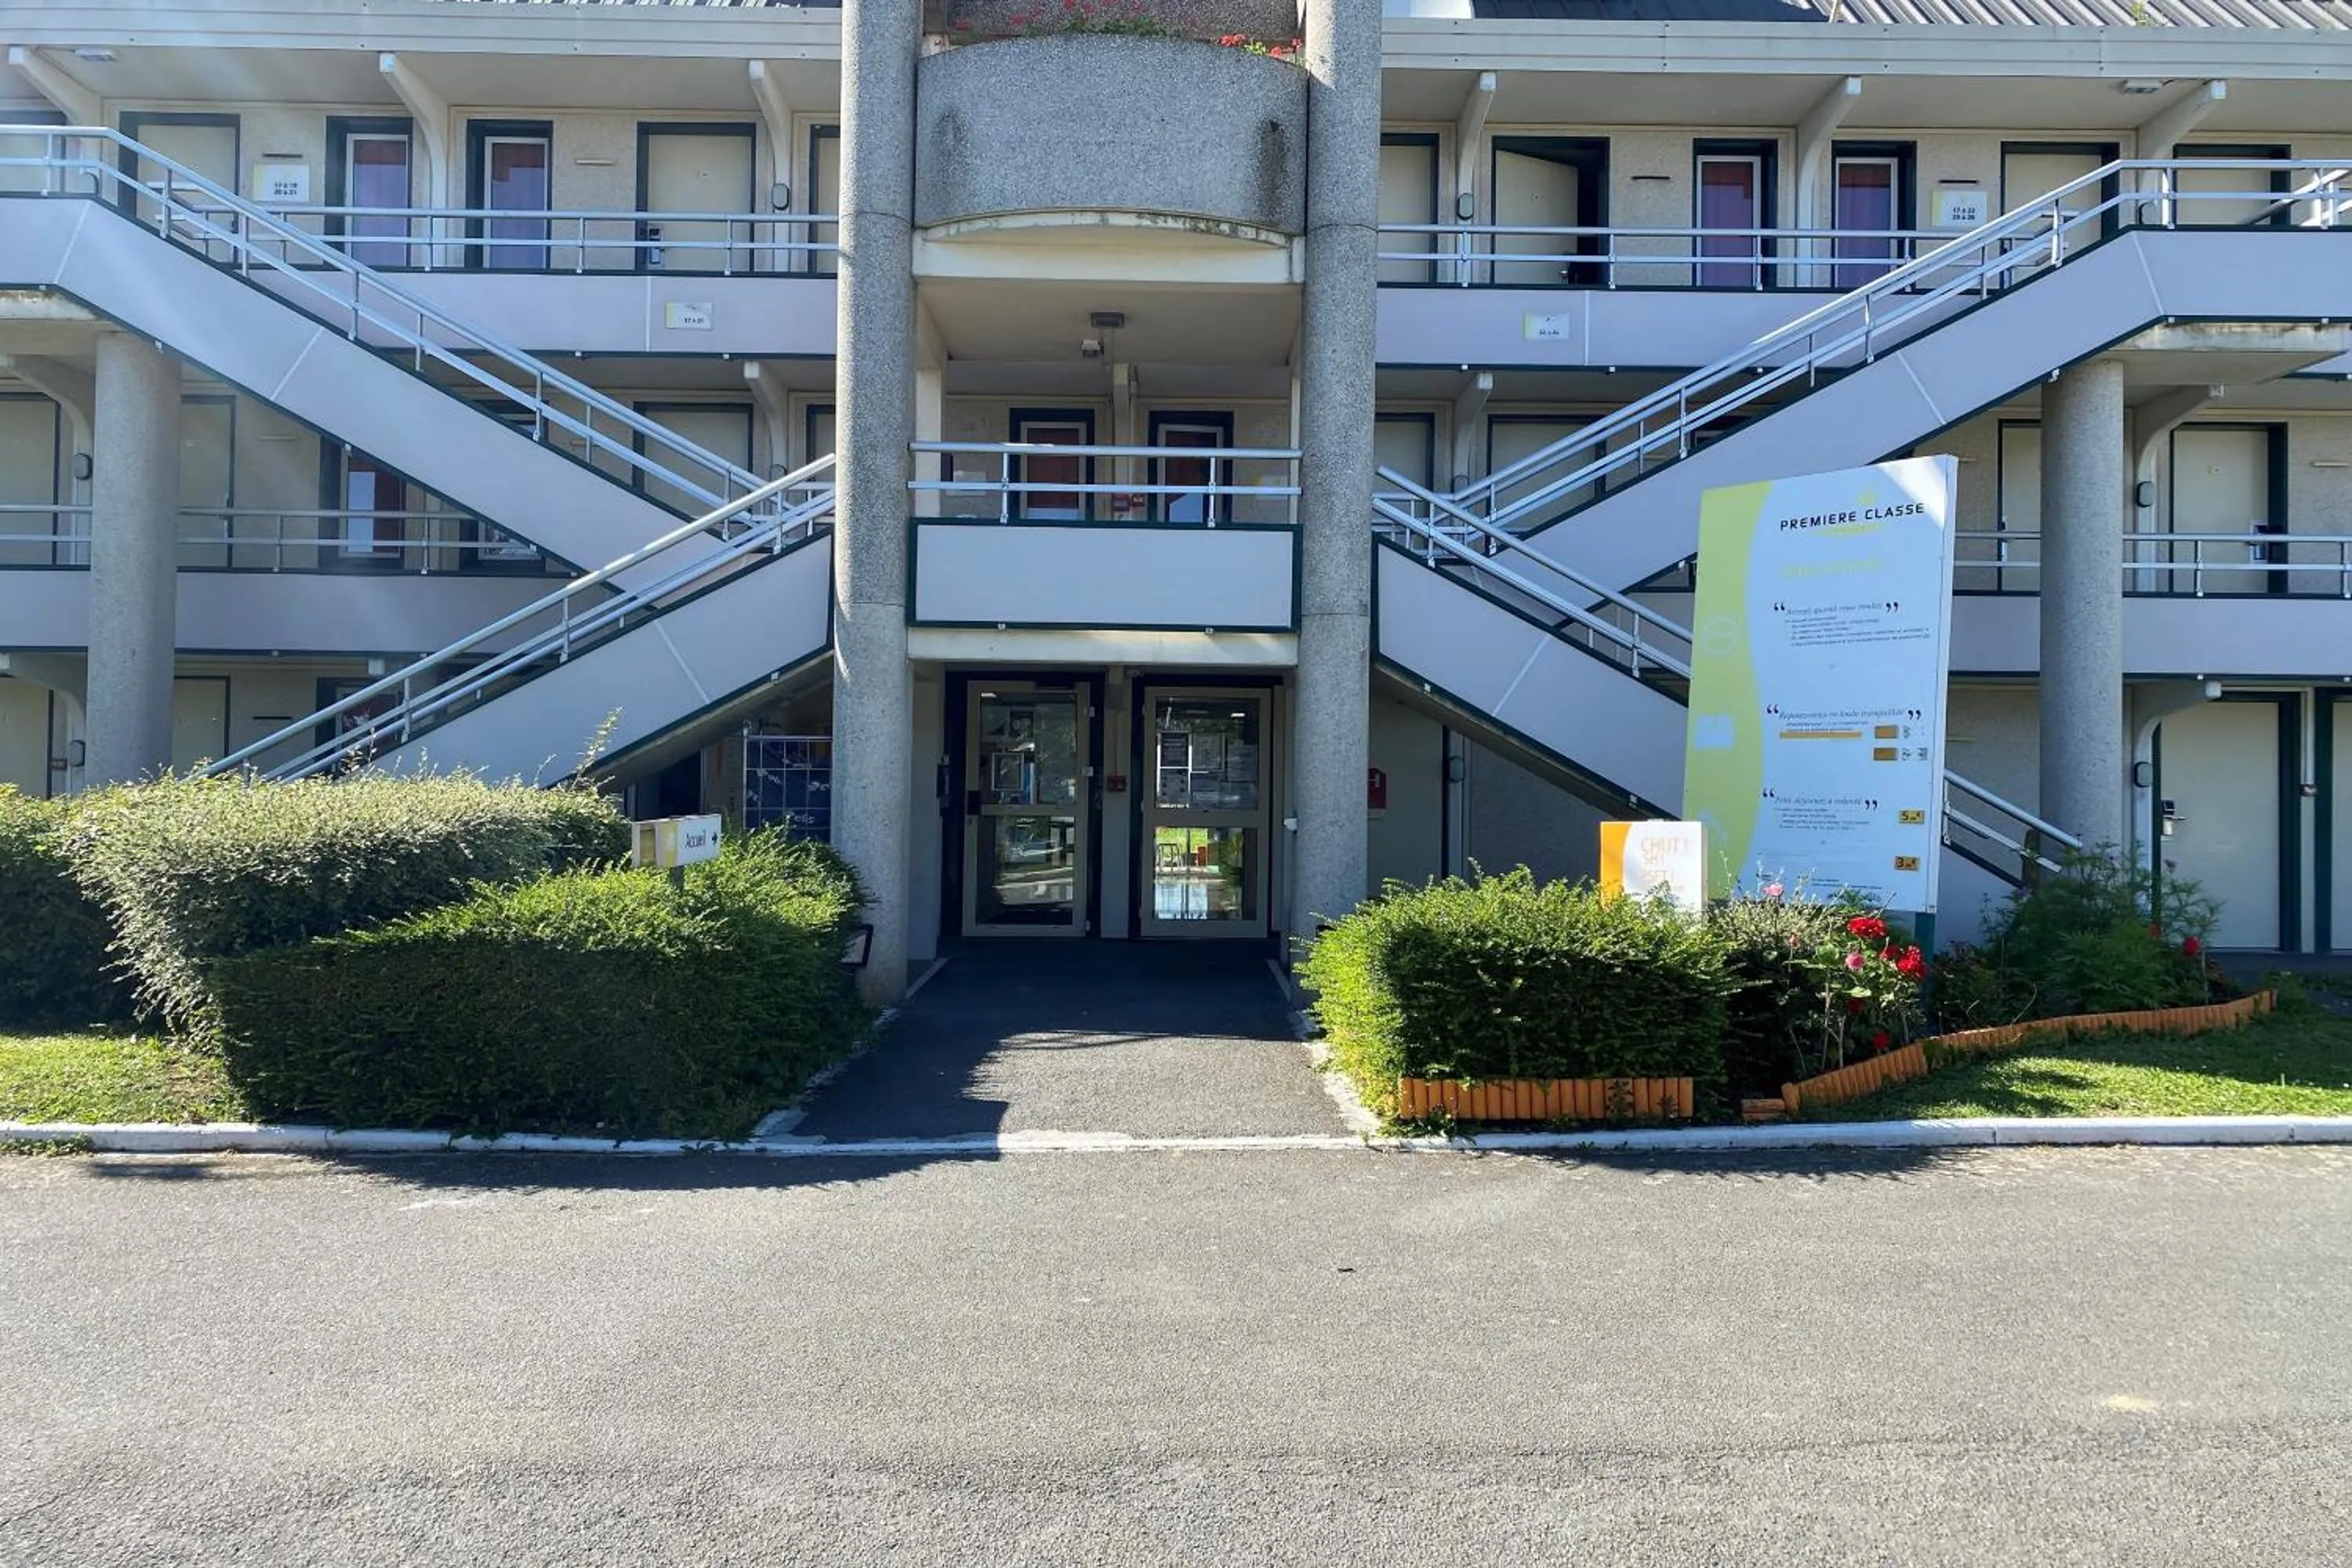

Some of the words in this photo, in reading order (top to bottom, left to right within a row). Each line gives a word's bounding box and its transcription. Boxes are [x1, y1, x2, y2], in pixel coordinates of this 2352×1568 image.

[1780, 511, 1857, 531] PREMIERE
[1865, 503, 1925, 520] CLASSE
[685, 829, 706, 848] Accueil
